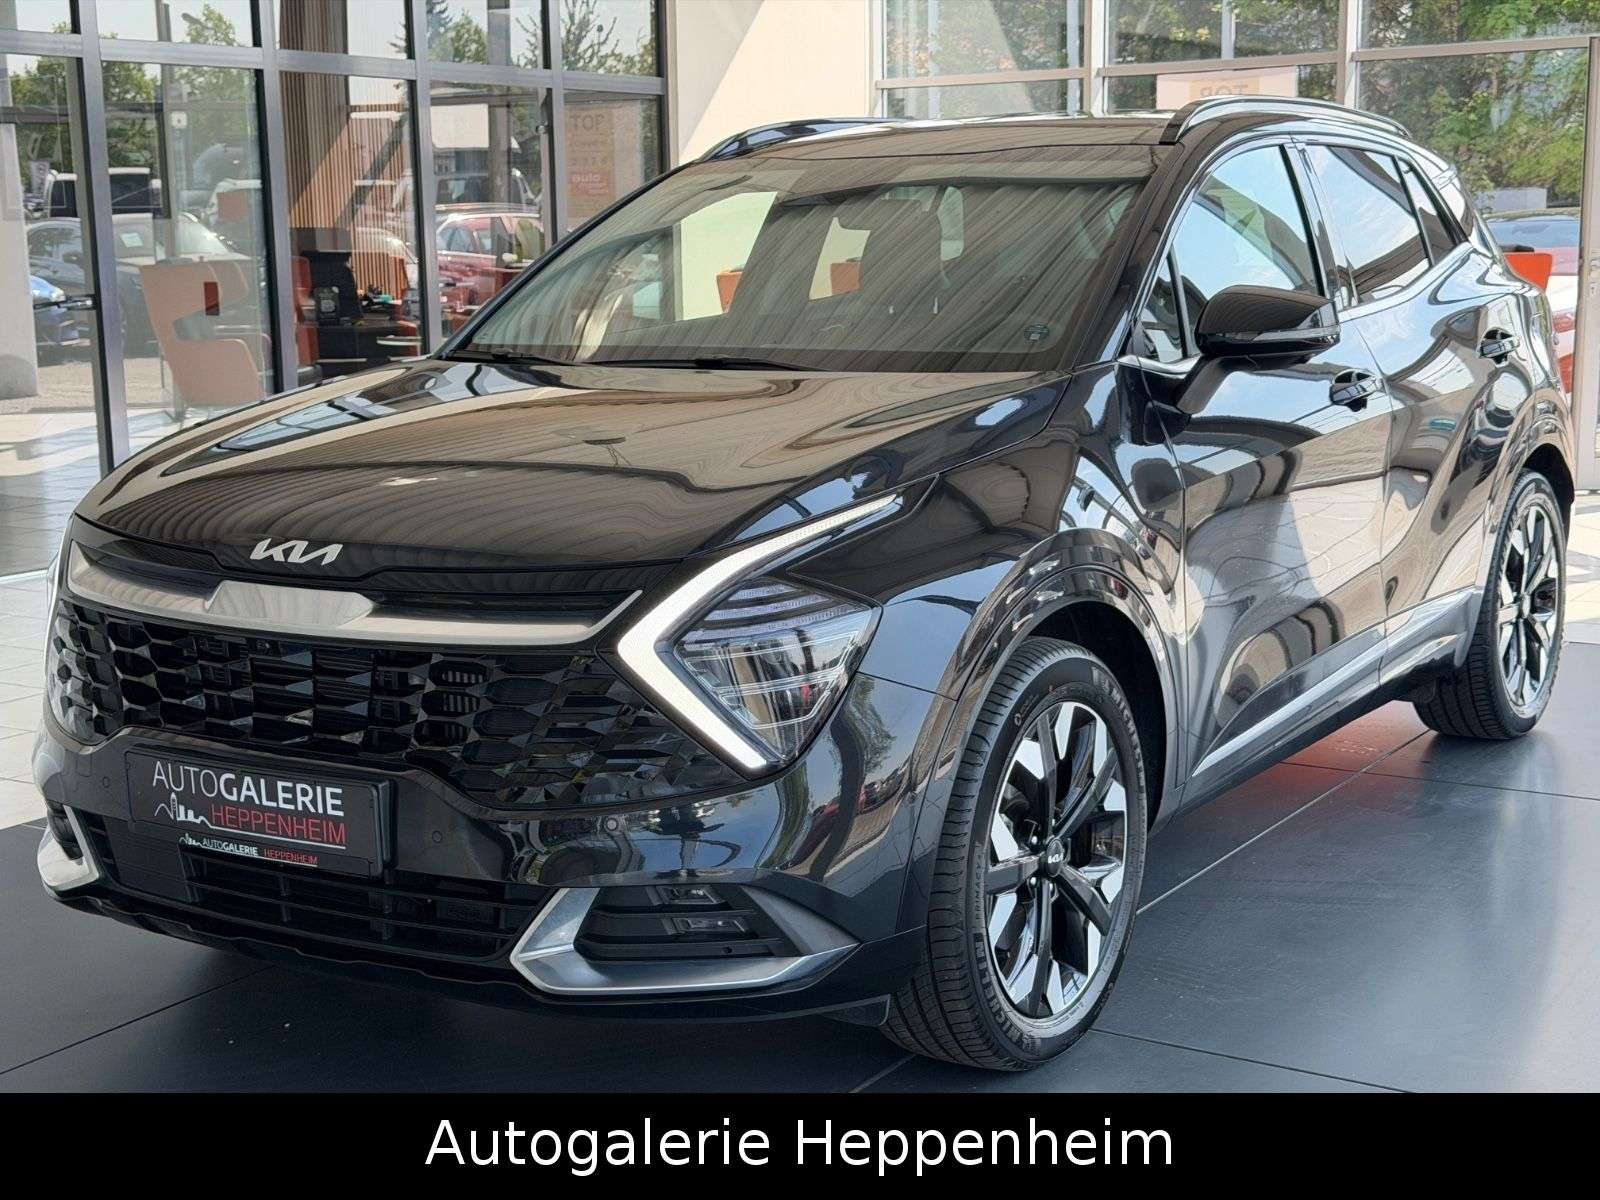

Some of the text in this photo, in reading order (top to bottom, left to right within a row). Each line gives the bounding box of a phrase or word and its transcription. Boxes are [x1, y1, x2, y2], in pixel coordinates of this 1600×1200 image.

[569, 113, 605, 130] TOP
[249, 538, 343, 565] KIA
[153, 760, 344, 817] AUTOGALERIE
[210, 803, 345, 844] HEPPENHEIM
[202, 837, 258, 857] AUTOGALERIE
[263, 848, 318, 864] HEPPENHEIM
